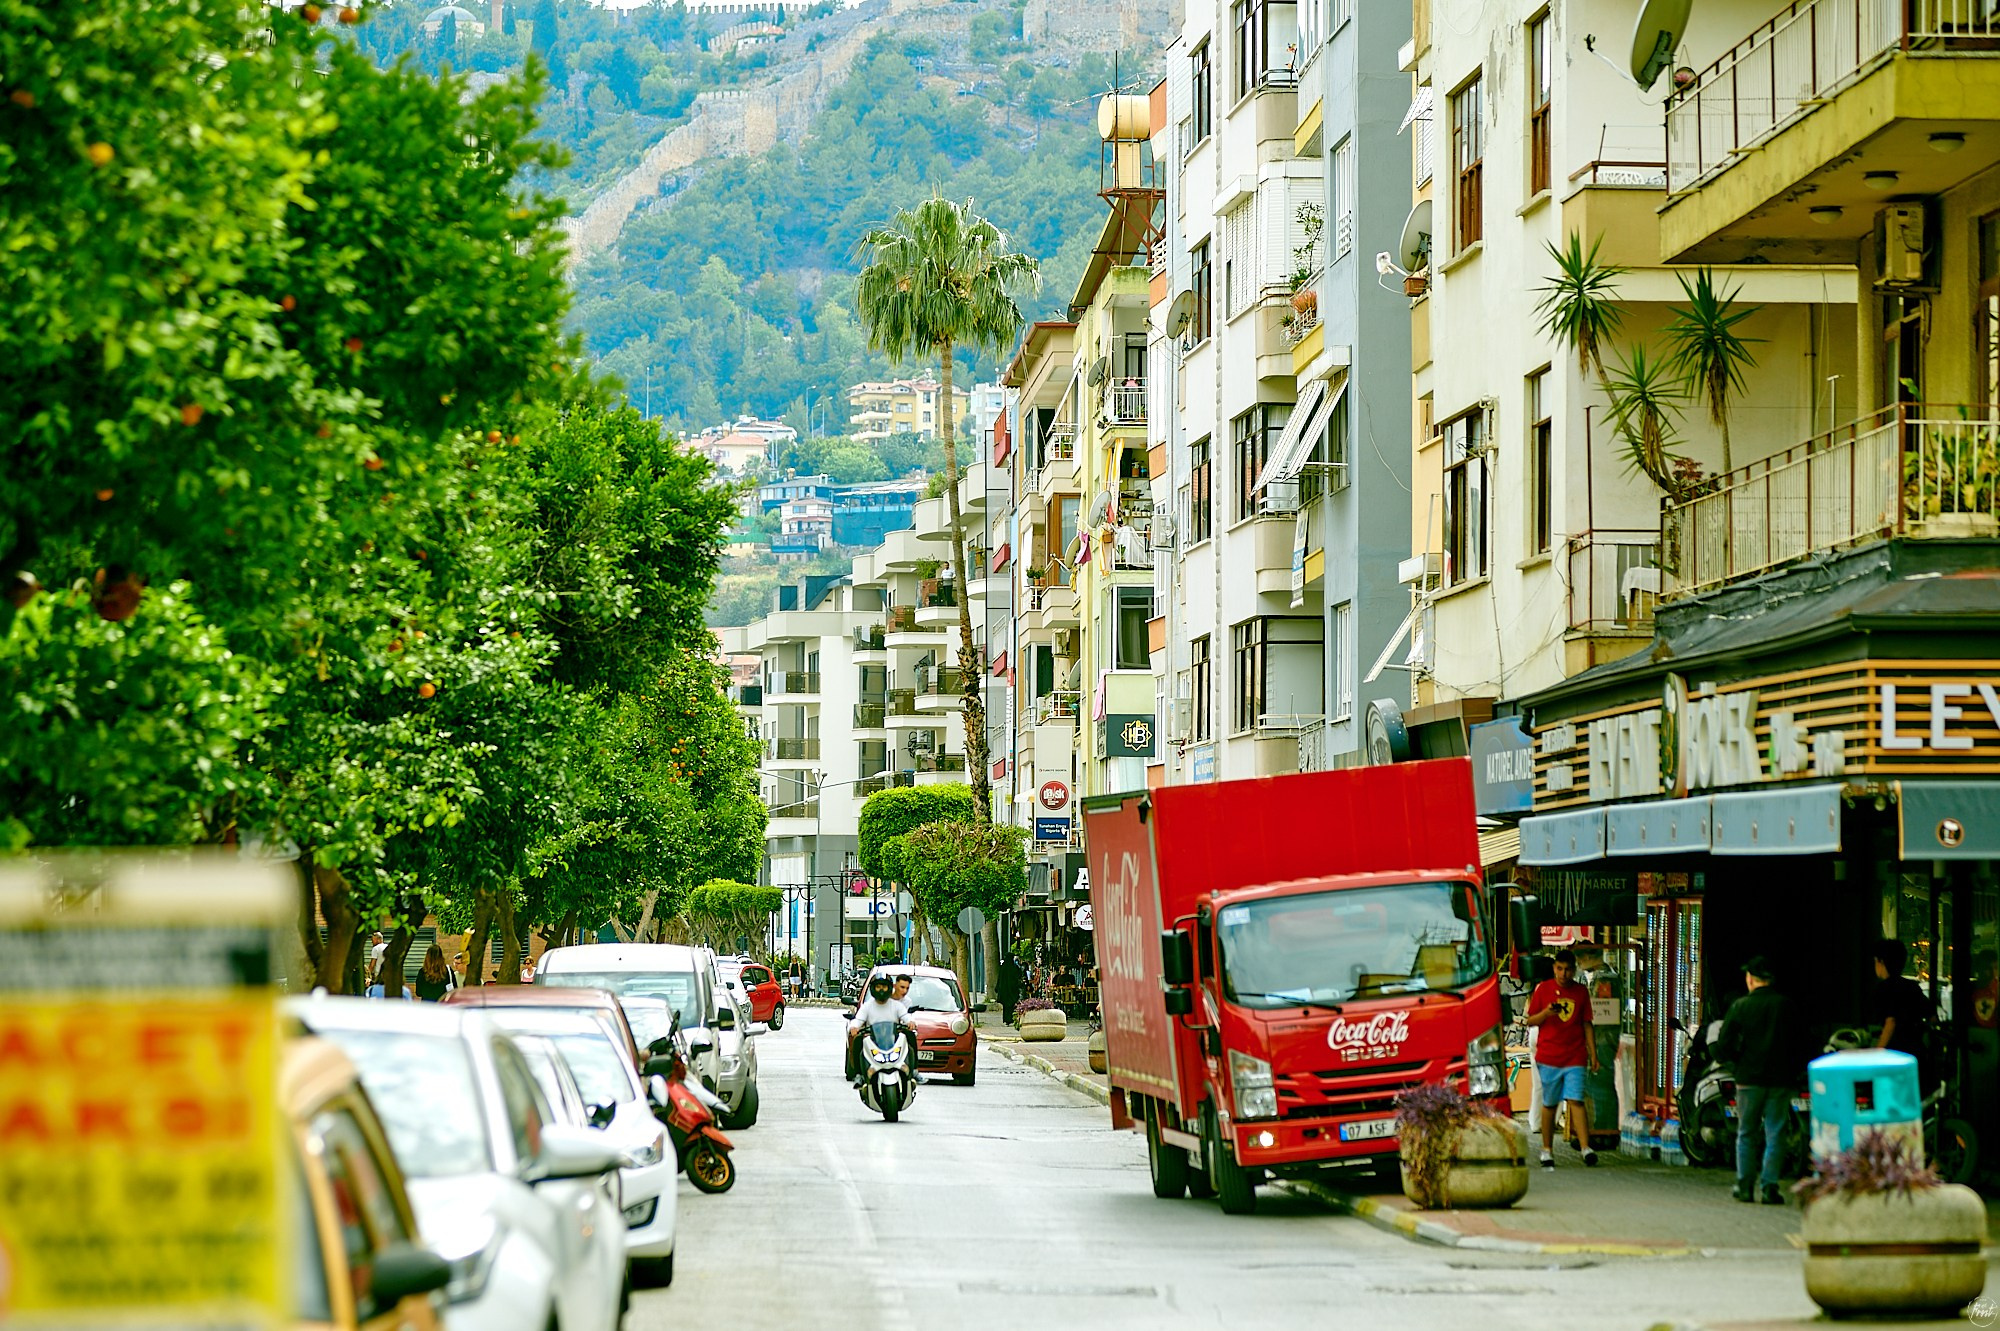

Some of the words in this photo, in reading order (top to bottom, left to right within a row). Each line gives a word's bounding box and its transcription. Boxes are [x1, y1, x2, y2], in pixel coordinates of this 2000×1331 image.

[1584, 878, 1627, 890] MARKET
[1340, 1044, 1399, 1062] ISUZU
[1348, 1125, 1361, 1139] 07
